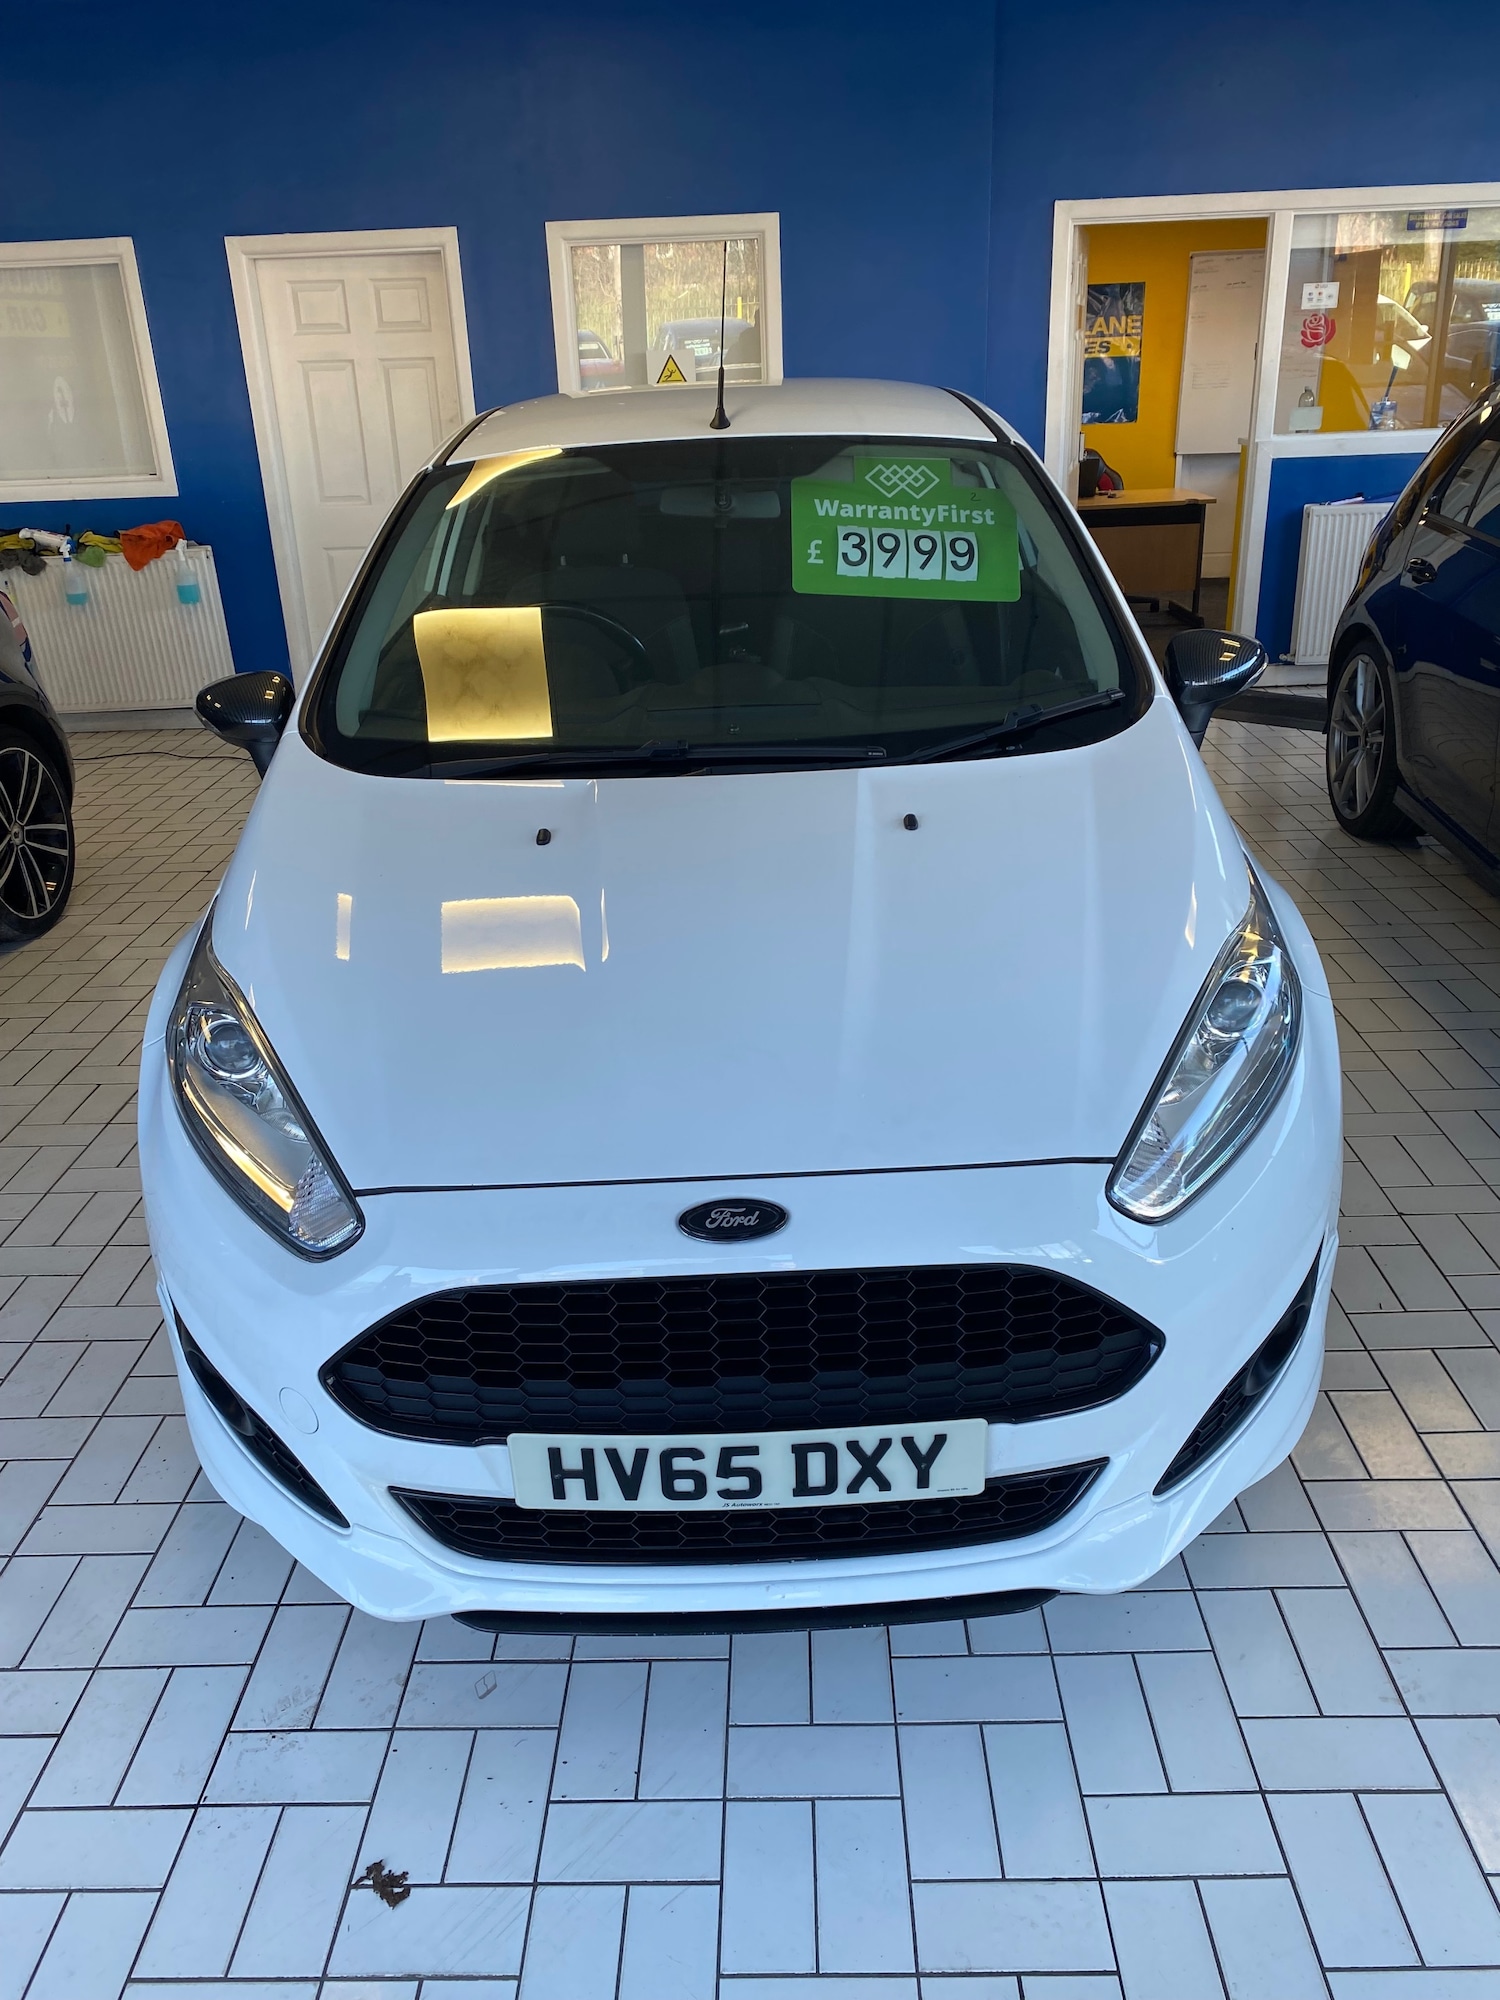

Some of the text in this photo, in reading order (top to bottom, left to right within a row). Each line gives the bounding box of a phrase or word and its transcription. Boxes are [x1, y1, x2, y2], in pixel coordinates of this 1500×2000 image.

[1085, 314, 1142, 336] ANE
[814, 499, 995, 526] WarrantyFirst
[807, 531, 976, 572] £ 3999
[705, 1207, 760, 1229] Ford
[547, 1433, 948, 1501] HV65 DXY
